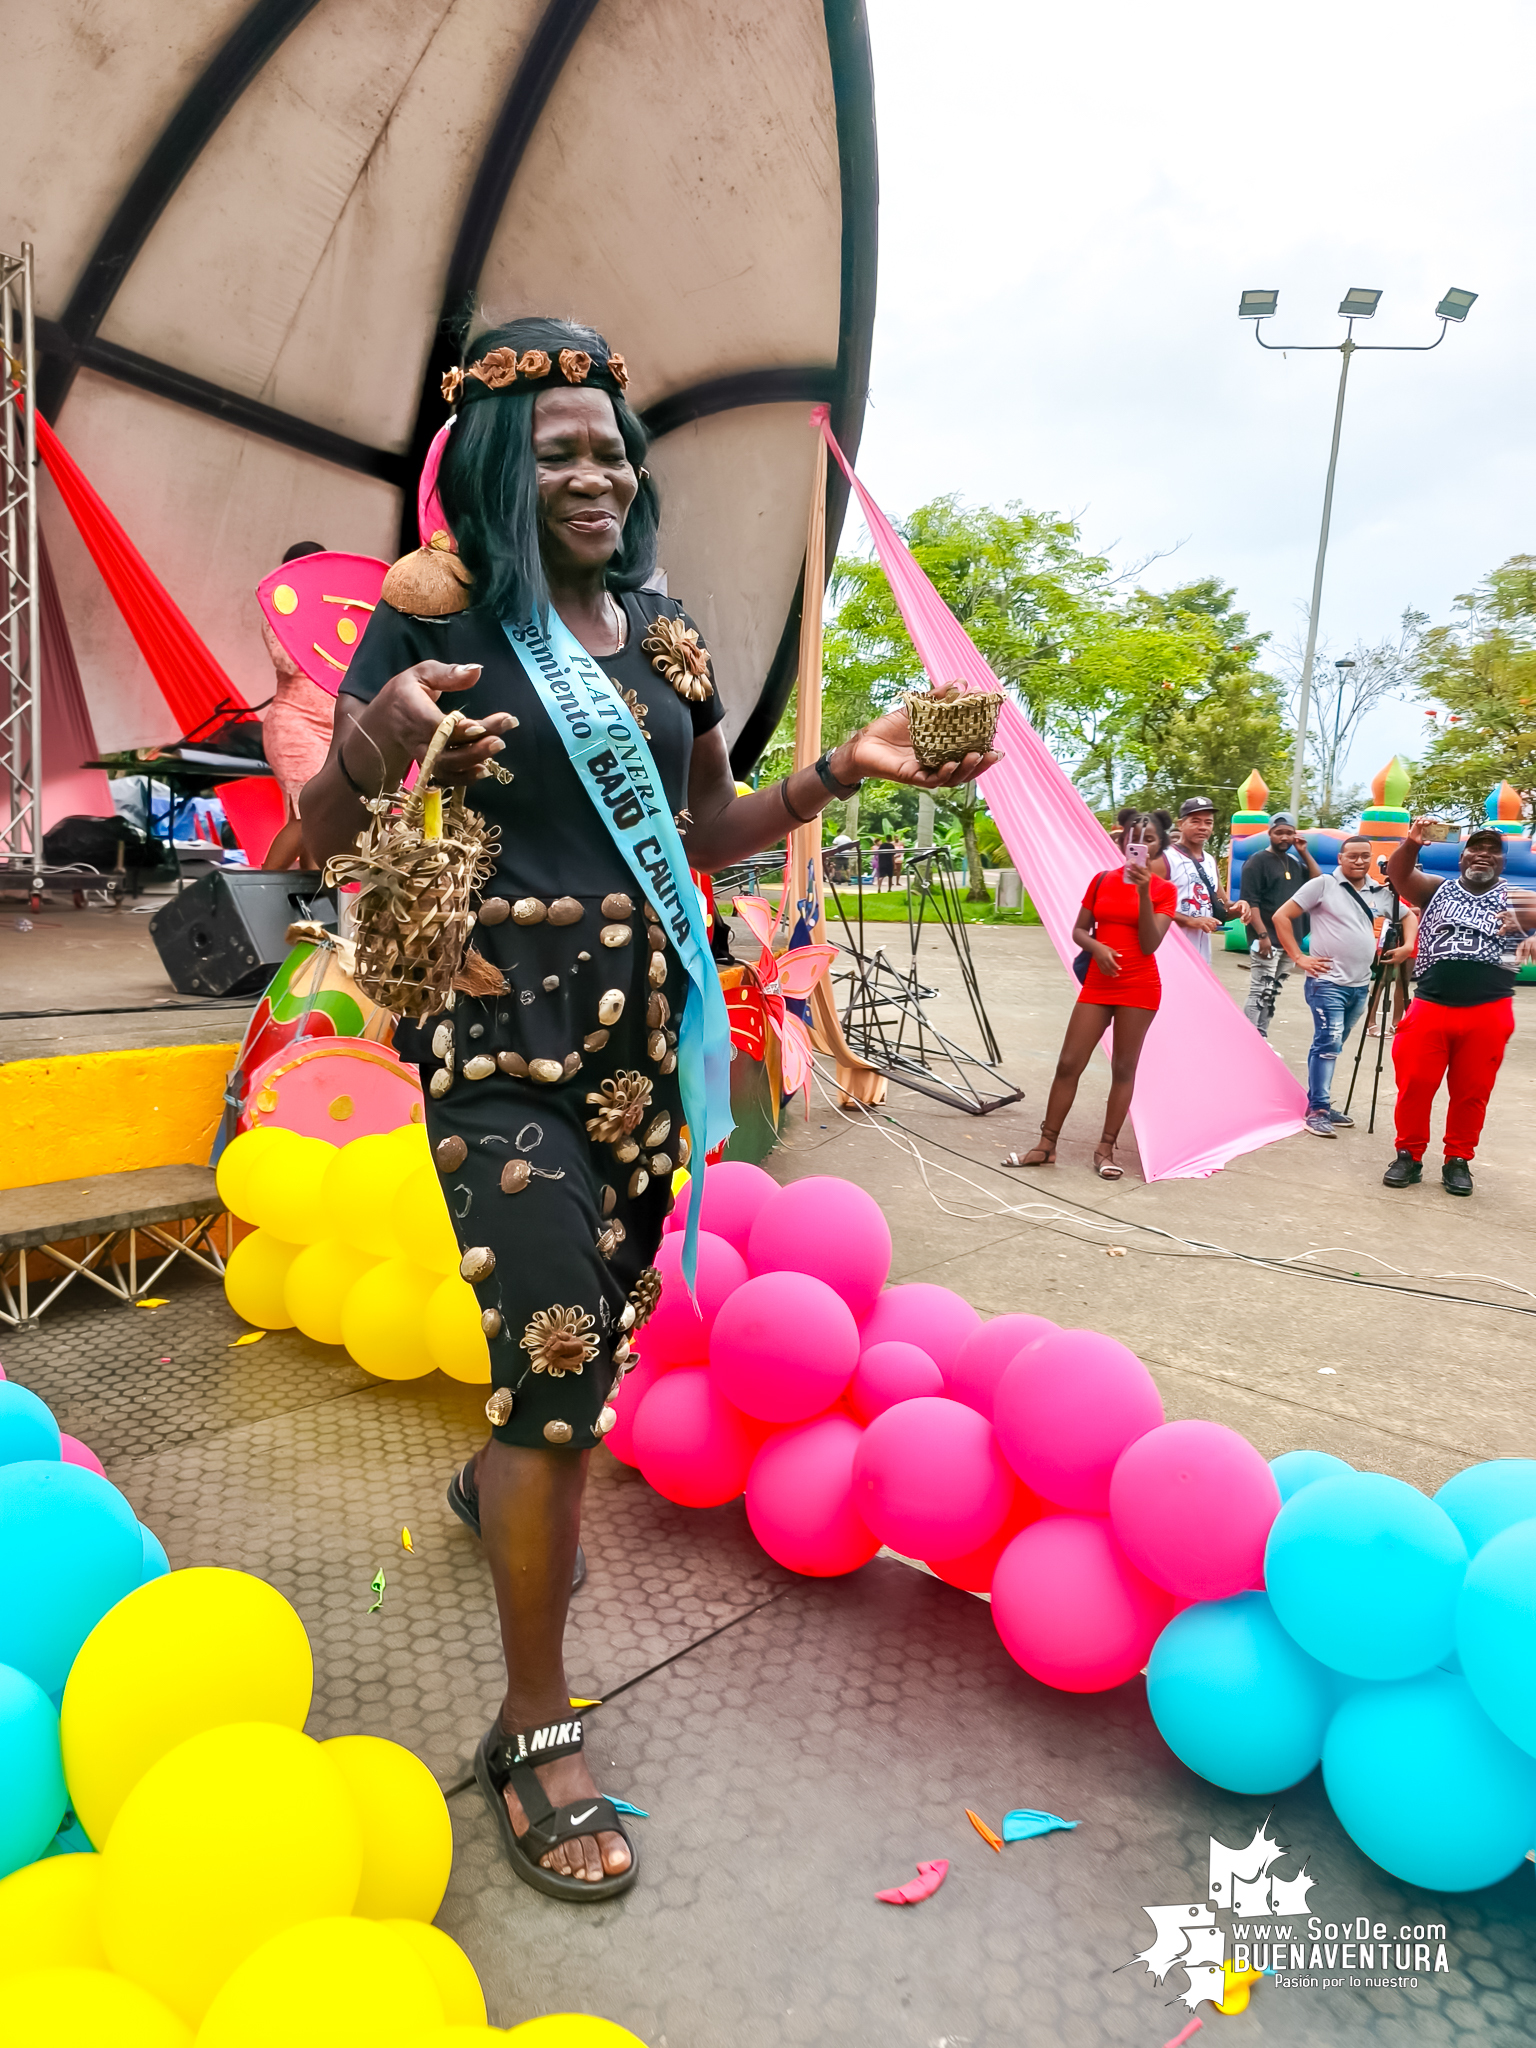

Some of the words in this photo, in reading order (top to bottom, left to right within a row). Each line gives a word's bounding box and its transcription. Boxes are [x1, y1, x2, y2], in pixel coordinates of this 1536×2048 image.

[569, 655, 662, 819] PLATONERA
[587, 749, 645, 830] BAJO
[633, 834, 691, 947] CALIMA
[1430, 922, 1483, 956] 23
[530, 1721, 582, 1751] NIKE
